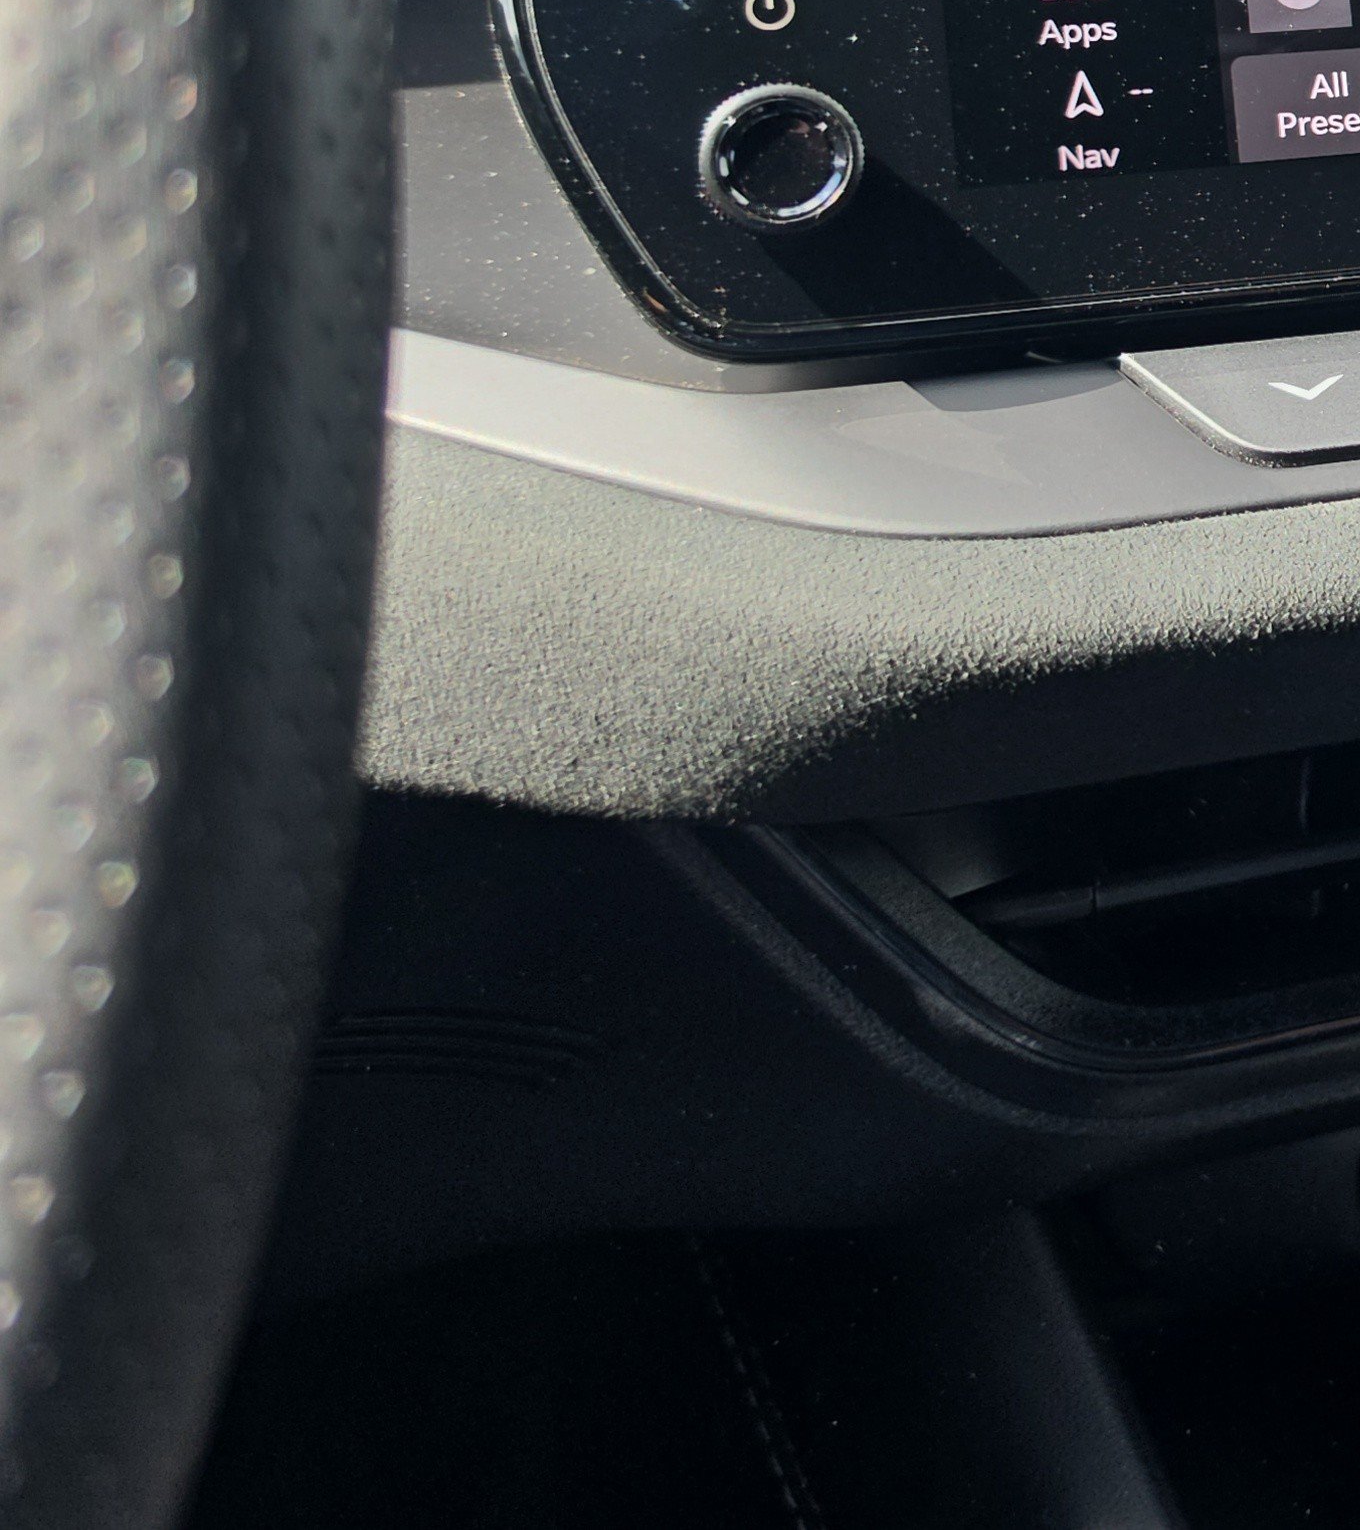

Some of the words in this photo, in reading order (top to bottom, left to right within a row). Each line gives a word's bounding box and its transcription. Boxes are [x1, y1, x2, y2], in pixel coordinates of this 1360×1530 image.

[1039, 20, 1117, 49] Apps
[1310, 71, 1348, 99] All
[1058, 145, 1119, 171] Nav
